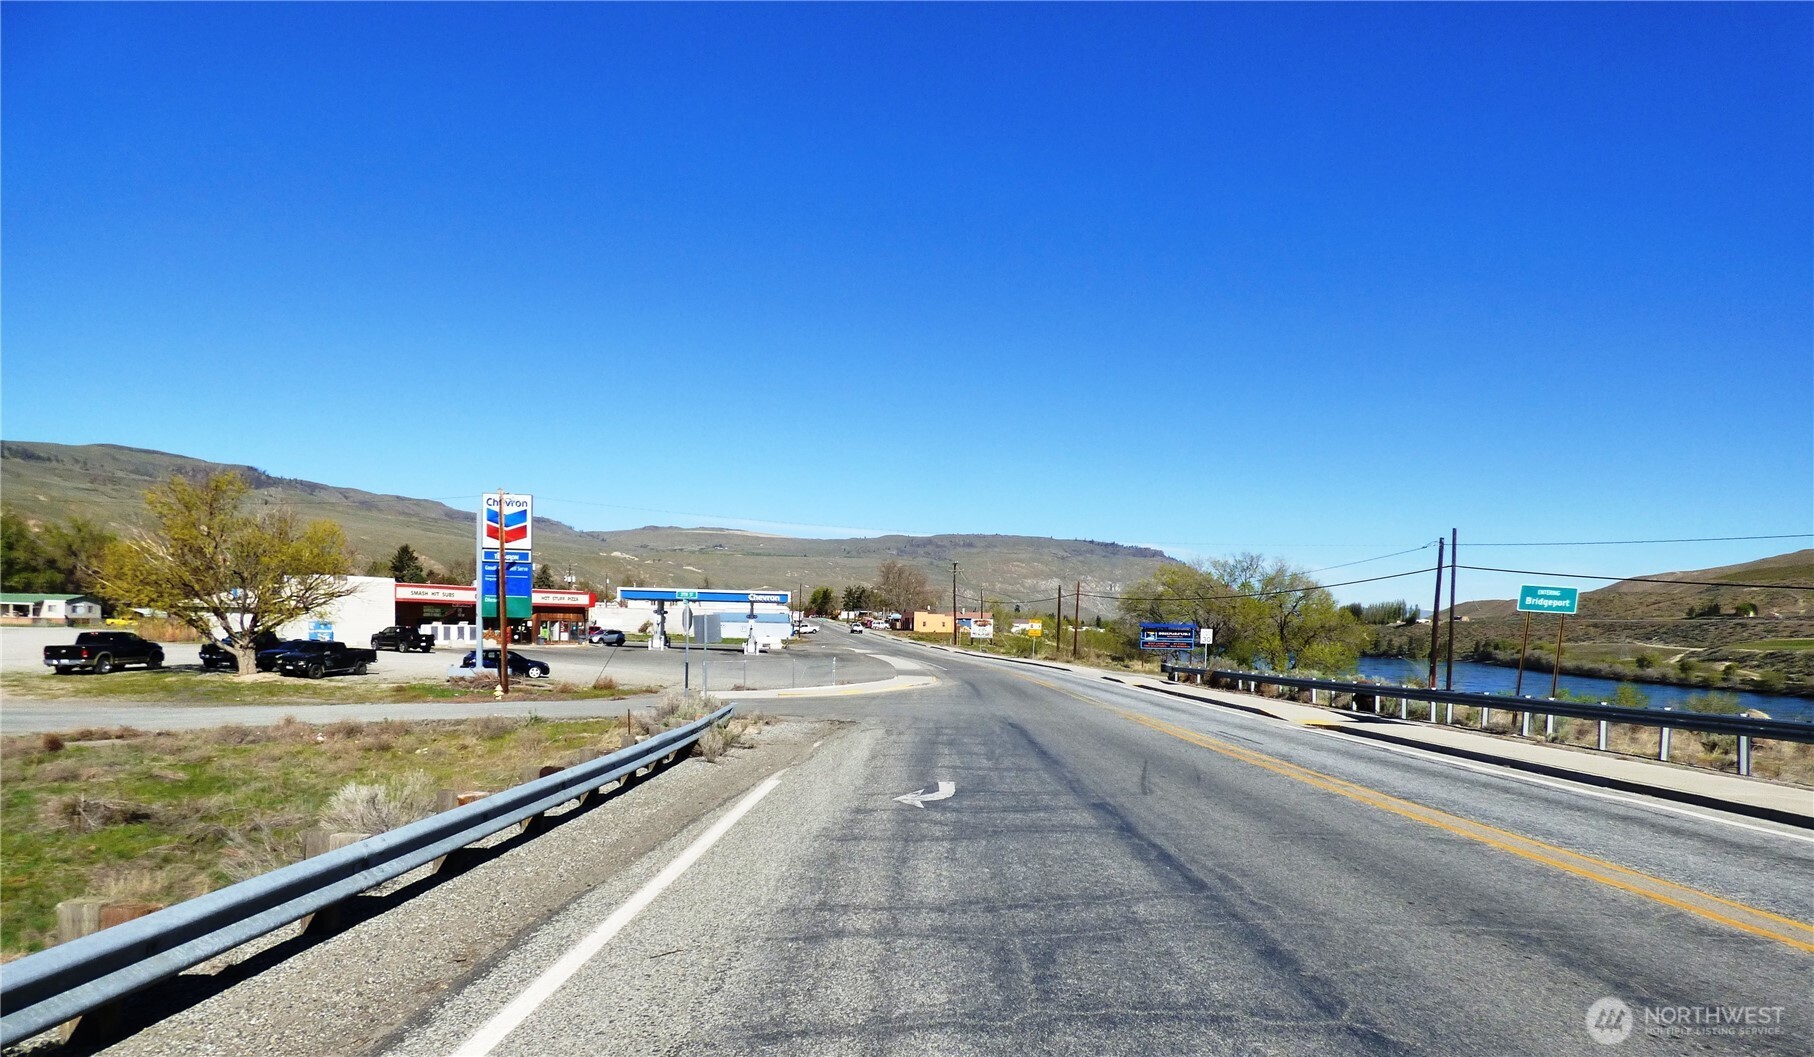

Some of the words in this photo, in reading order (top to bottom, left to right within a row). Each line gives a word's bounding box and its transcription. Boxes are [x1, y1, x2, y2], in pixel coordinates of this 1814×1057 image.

[486, 497, 528, 508] Chvron
[748, 594, 780, 602] Chevron
[1525, 597, 1570, 608] Bridgeport
